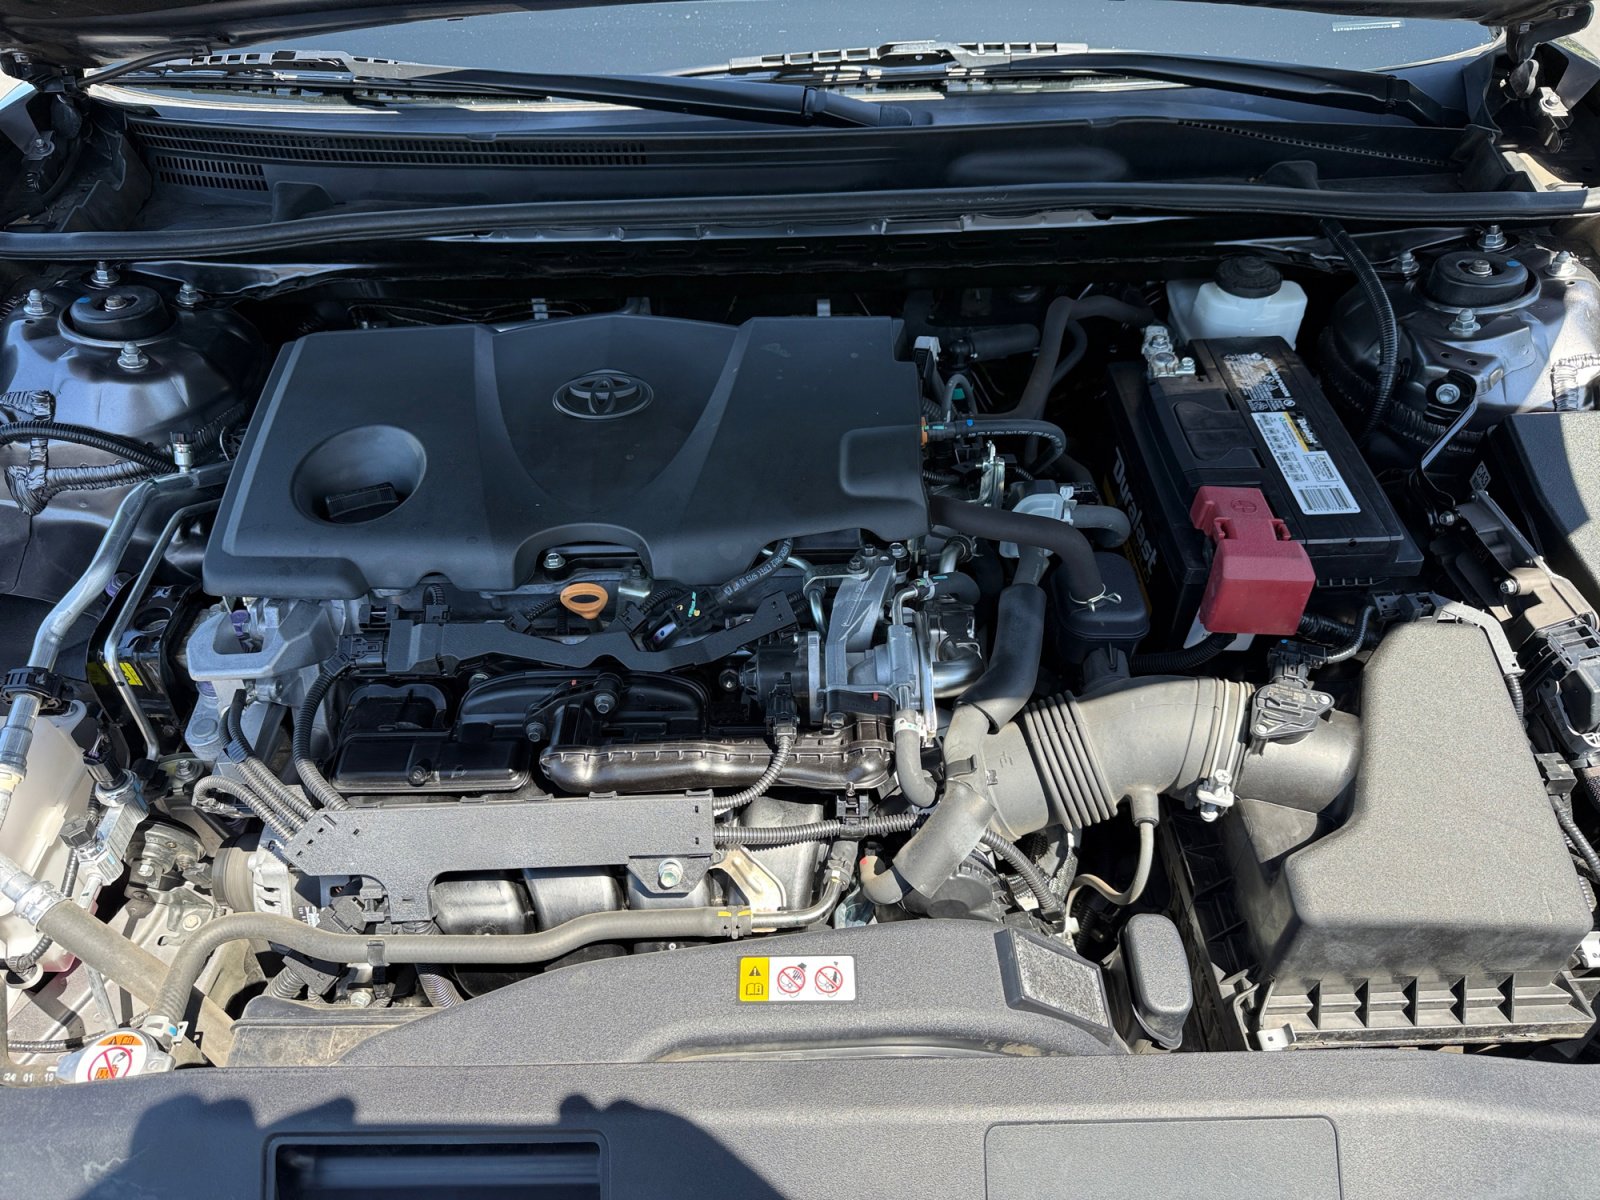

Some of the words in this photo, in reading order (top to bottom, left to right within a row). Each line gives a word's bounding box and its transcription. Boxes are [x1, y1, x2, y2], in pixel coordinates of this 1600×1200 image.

[1113, 447, 1157, 575] Duralast
[23, 1072, 34, 1083] 01
[44, 1072, 55, 1083] 19
